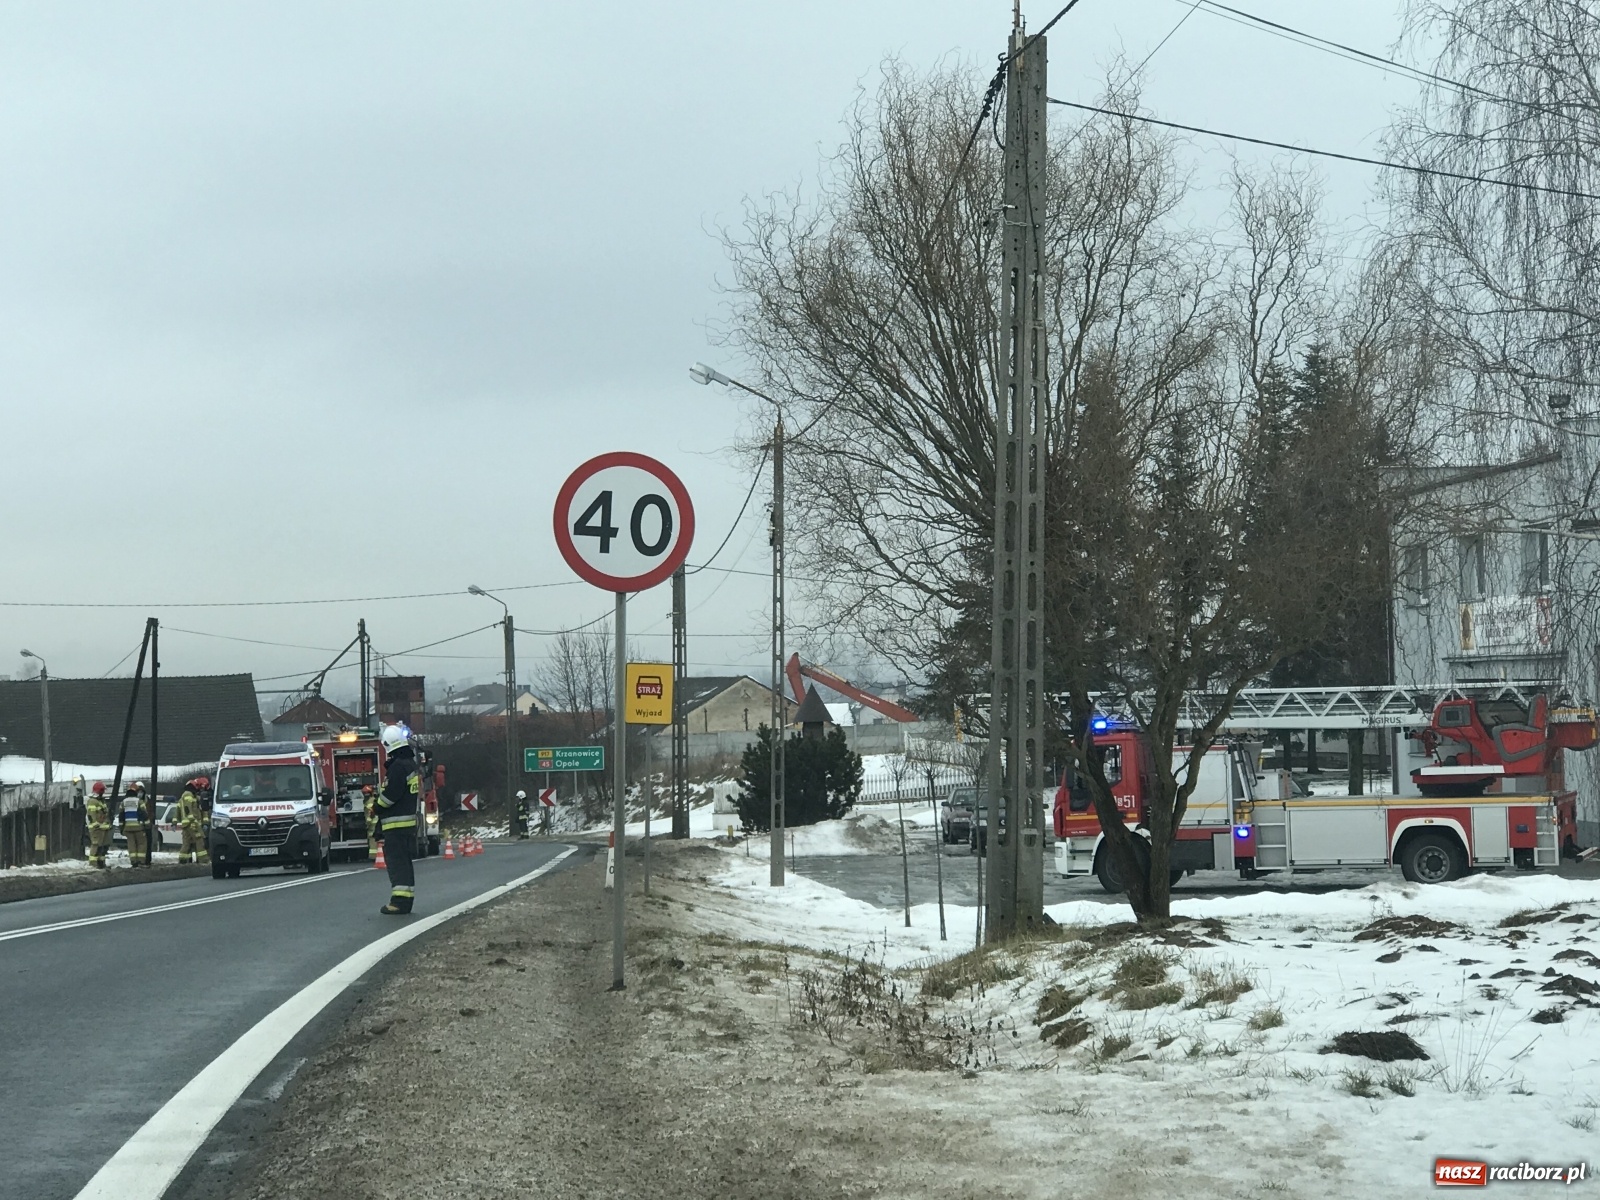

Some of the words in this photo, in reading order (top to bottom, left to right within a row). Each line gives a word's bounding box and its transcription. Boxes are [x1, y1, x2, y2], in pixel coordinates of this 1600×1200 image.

[573, 490, 673, 557] 40
[637, 685, 662, 694] STRAŻ
[635, 709, 663, 718] Wyjazd
[555, 749, 600, 758] Krzanowice
[555, 759, 580, 769] Opole
